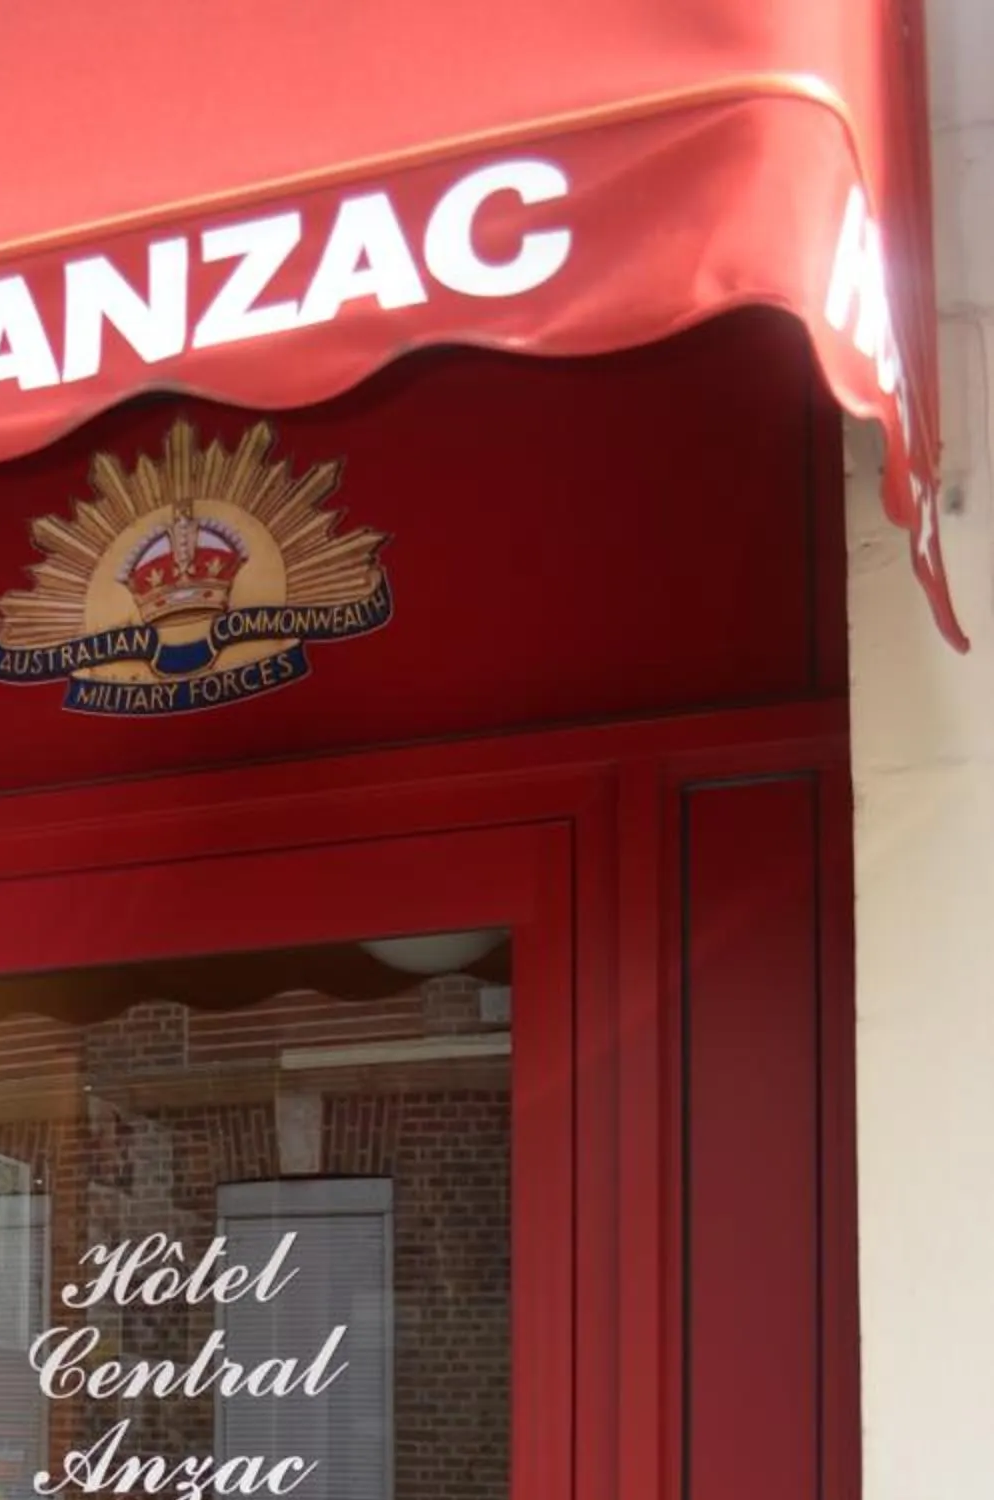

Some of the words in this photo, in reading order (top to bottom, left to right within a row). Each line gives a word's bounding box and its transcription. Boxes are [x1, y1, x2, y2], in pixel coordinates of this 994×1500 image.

[213, 590, 388, 638] COMMONWEALTH
[77, 682, 178, 713] MILITARY
[189, 652, 294, 702] FORCES
[61, 1231, 301, 1309] Hôtel
[28, 1325, 349, 1400] Central
